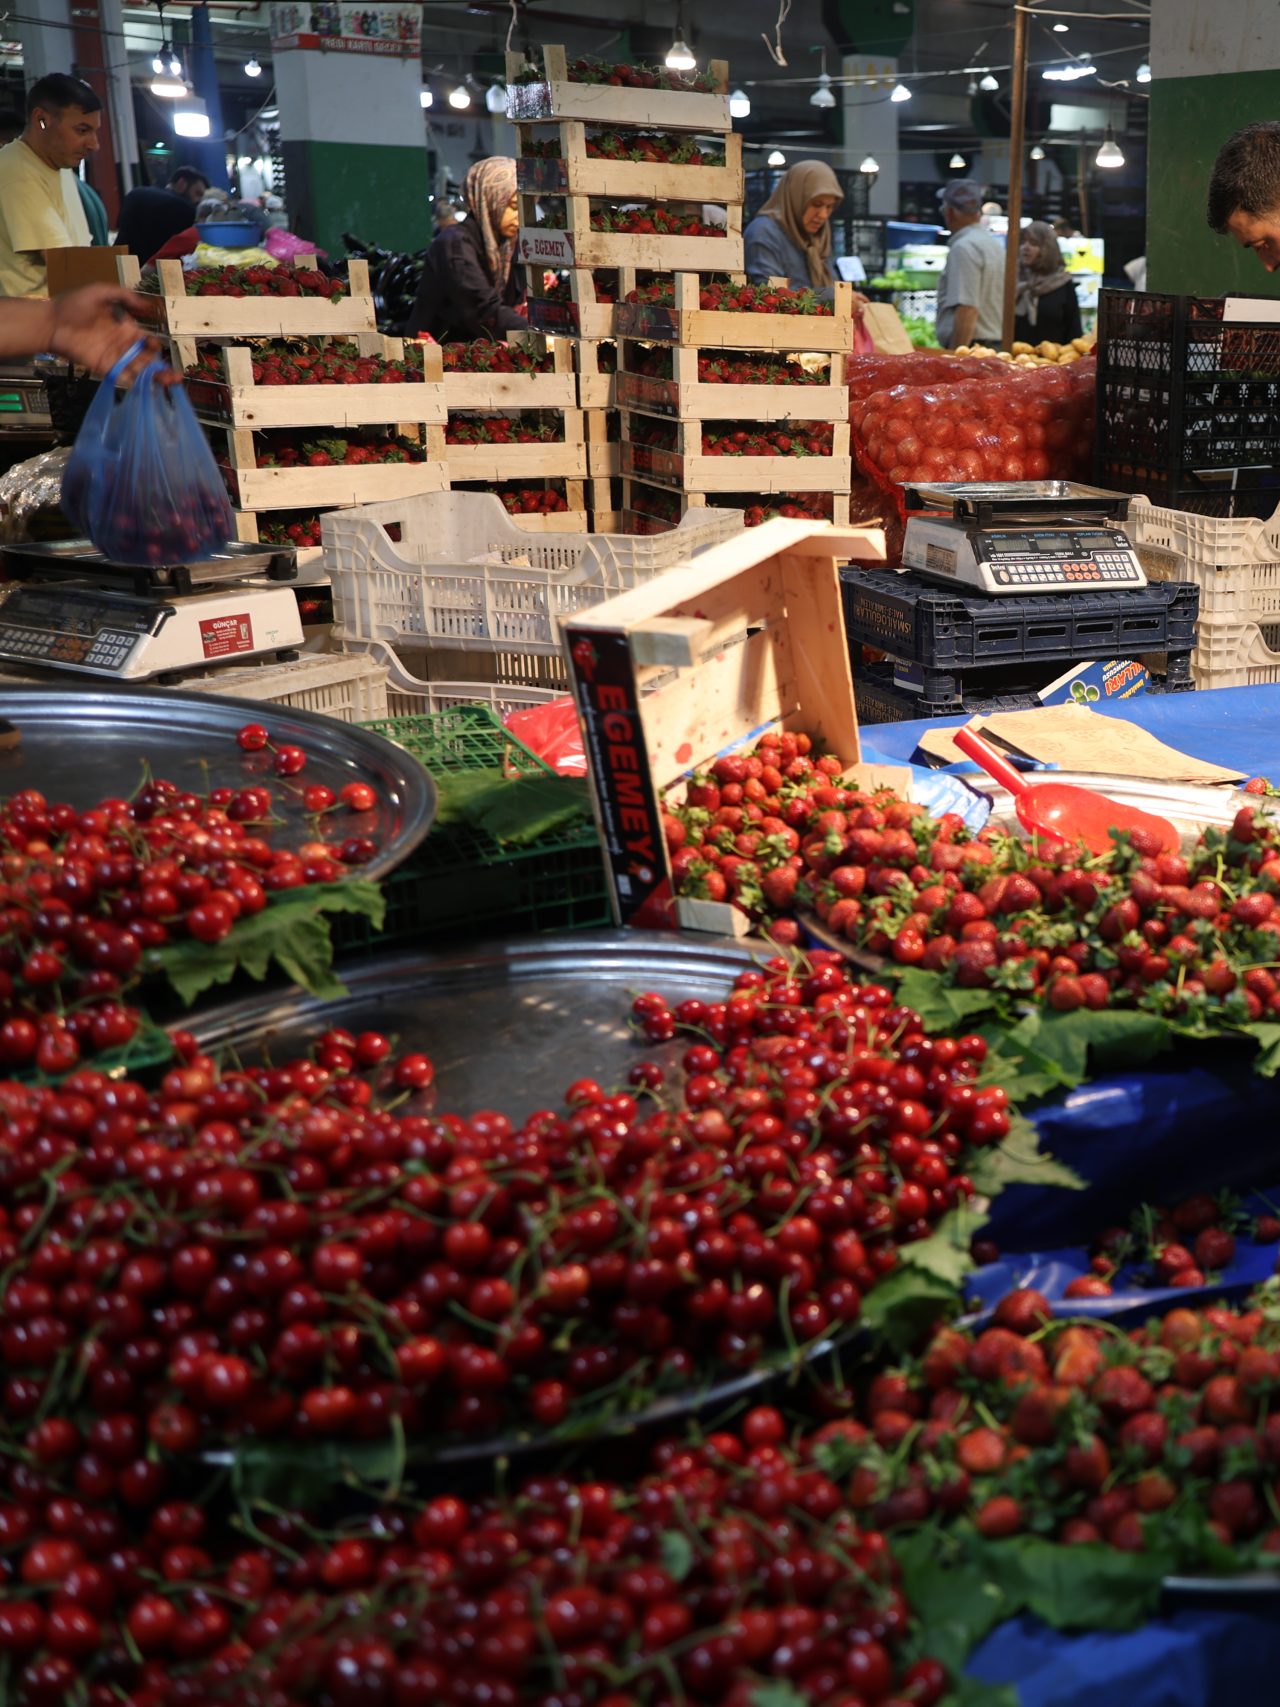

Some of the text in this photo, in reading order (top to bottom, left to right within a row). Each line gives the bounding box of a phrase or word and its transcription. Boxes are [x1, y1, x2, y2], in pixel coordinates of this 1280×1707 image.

[533, 239, 565, 257] EGEMEY
[212, 619, 238, 629] GÜNÇAR
[596, 684, 656, 863] EGEMEY
